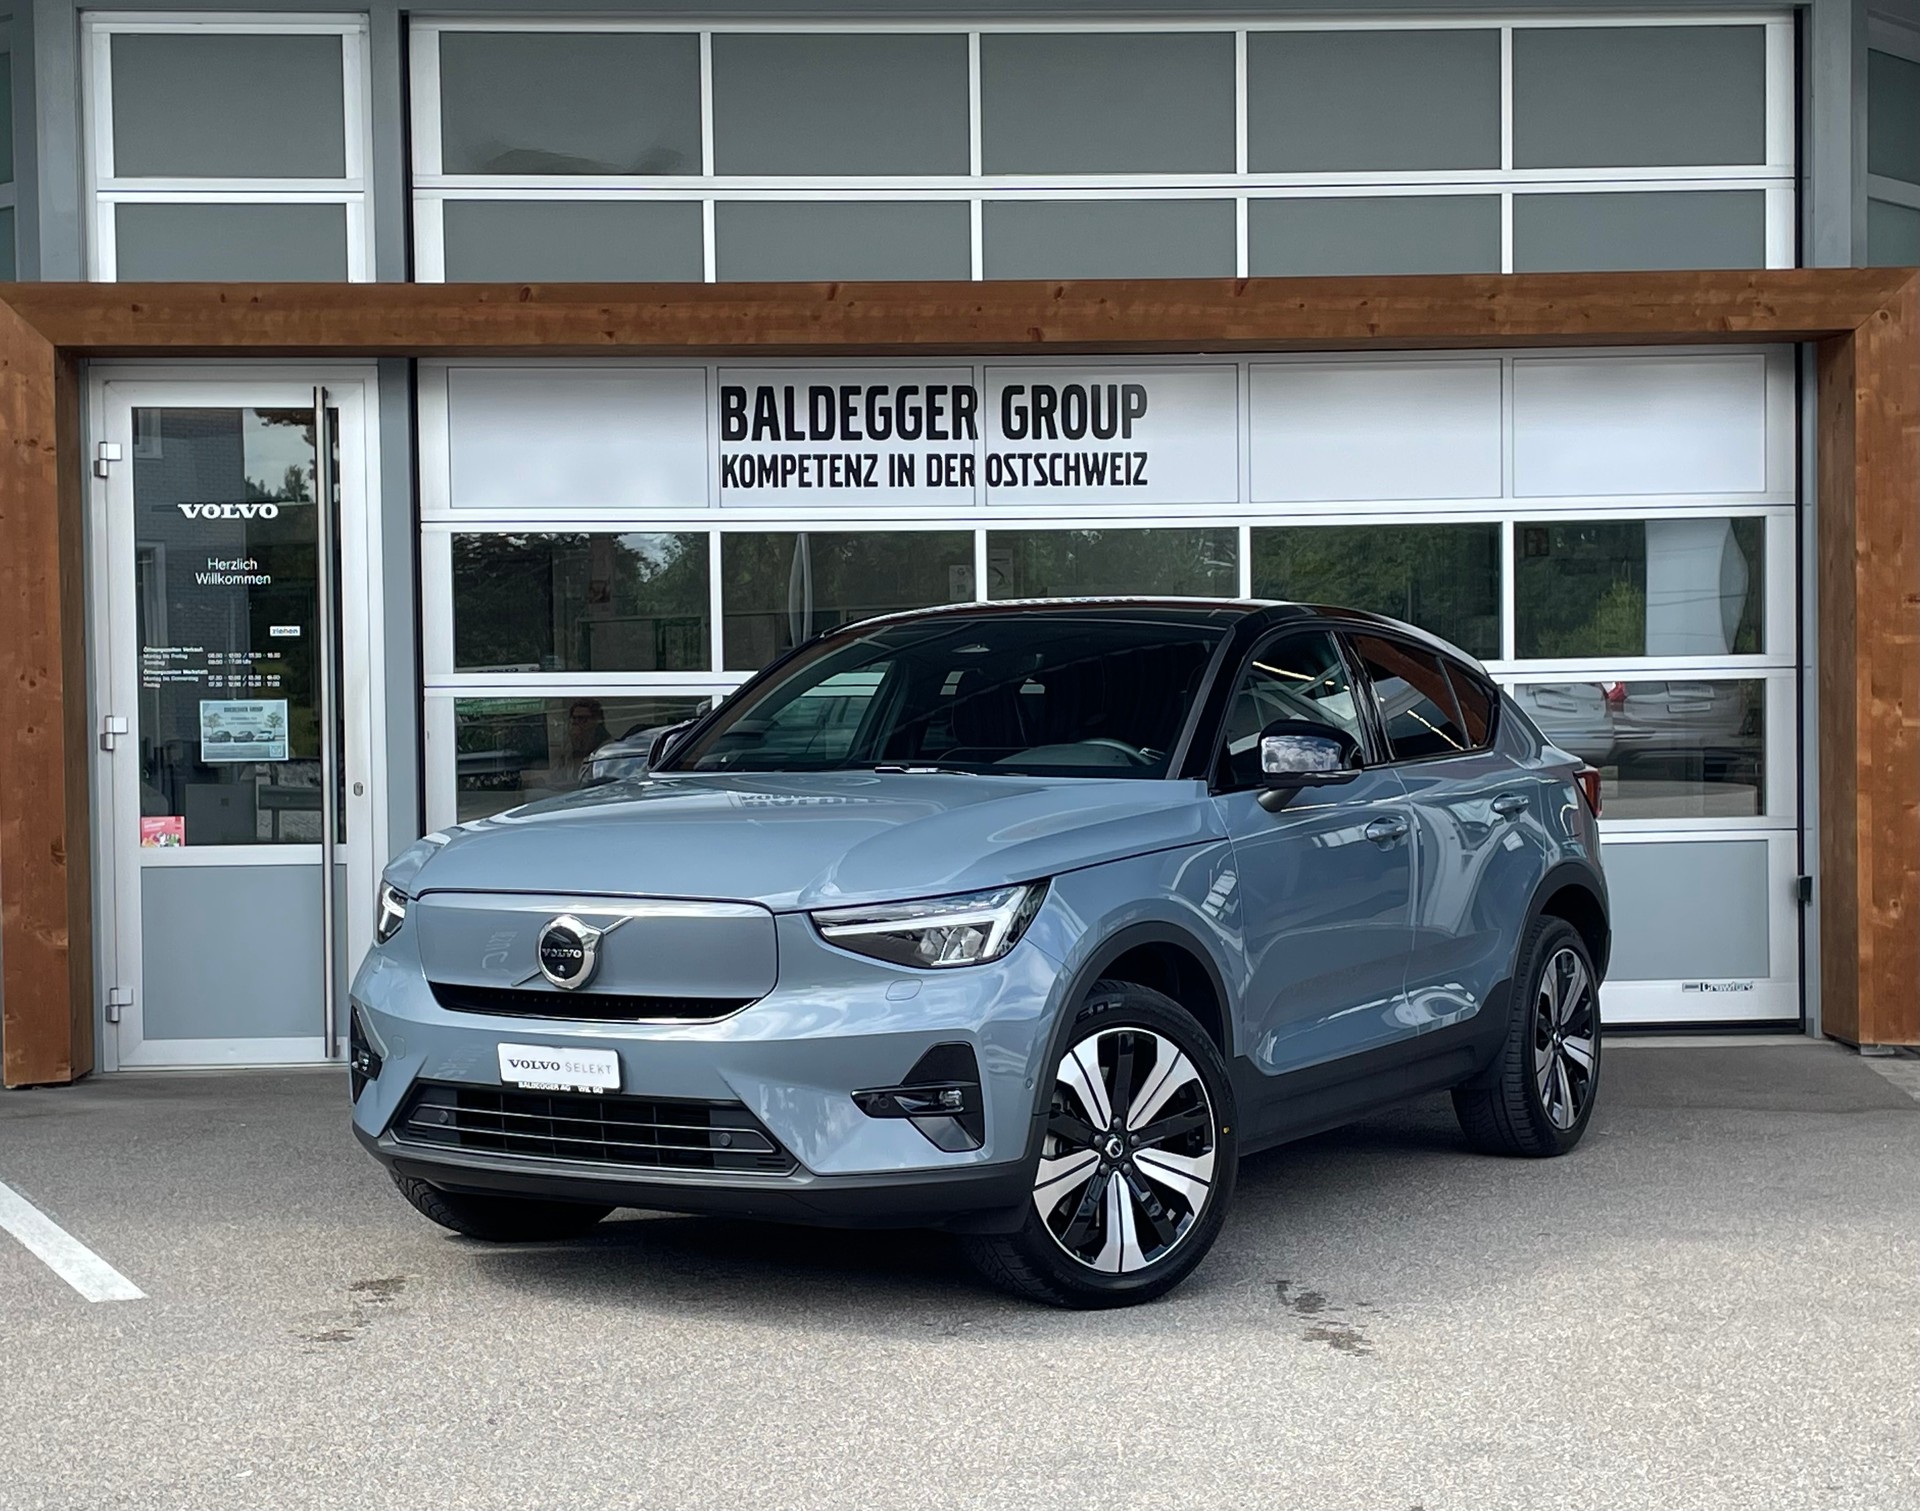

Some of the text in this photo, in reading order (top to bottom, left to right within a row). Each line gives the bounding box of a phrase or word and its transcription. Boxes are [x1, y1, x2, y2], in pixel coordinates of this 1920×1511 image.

[720, 383, 1148, 442] BALDEGGER GROUP
[721, 451, 1148, 489] KOMPETENZ IN DER OSTSCHWEIZ
[177, 503, 279, 519] VOLVO
[207, 557, 258, 571] Herzlich
[195, 572, 271, 585] Willkommen
[542, 947, 582, 959] VOLVO
[508, 1058, 613, 1075] VOLVO SELEKT
